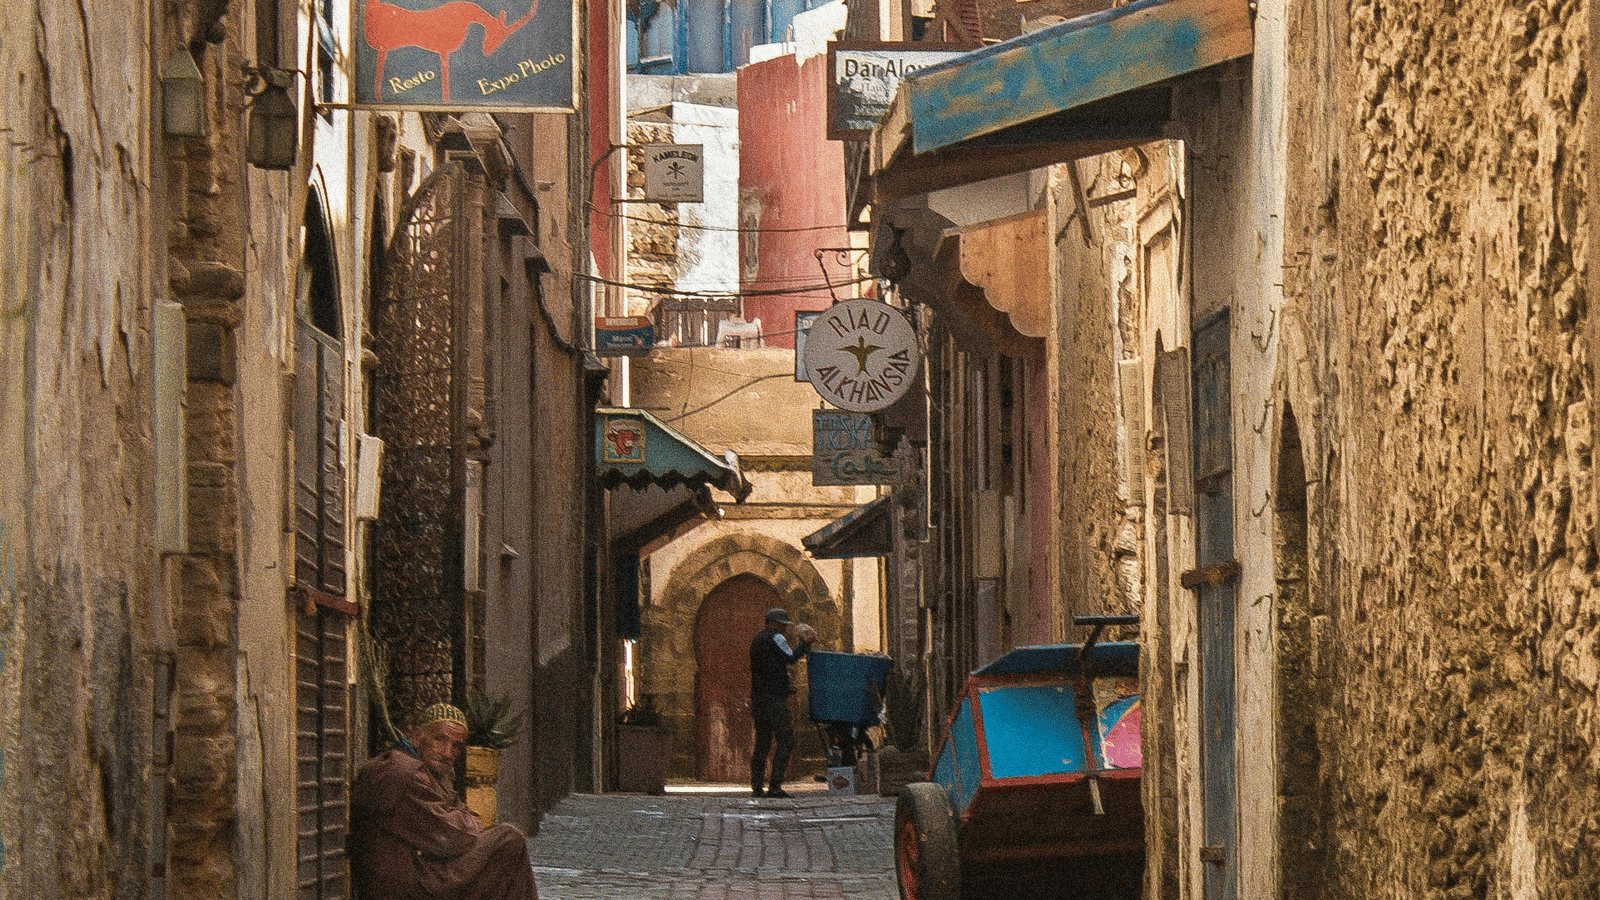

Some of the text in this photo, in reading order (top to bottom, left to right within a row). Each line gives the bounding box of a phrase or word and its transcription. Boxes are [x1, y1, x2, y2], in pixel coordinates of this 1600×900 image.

[388, 69, 436, 95] Resto
[476, 53, 567, 96] Expo Photo
[844, 58, 928, 77] Dar Alo
[828, 306, 891, 339] RIAD
[815, 349, 911, 404] ALKHANSAA
